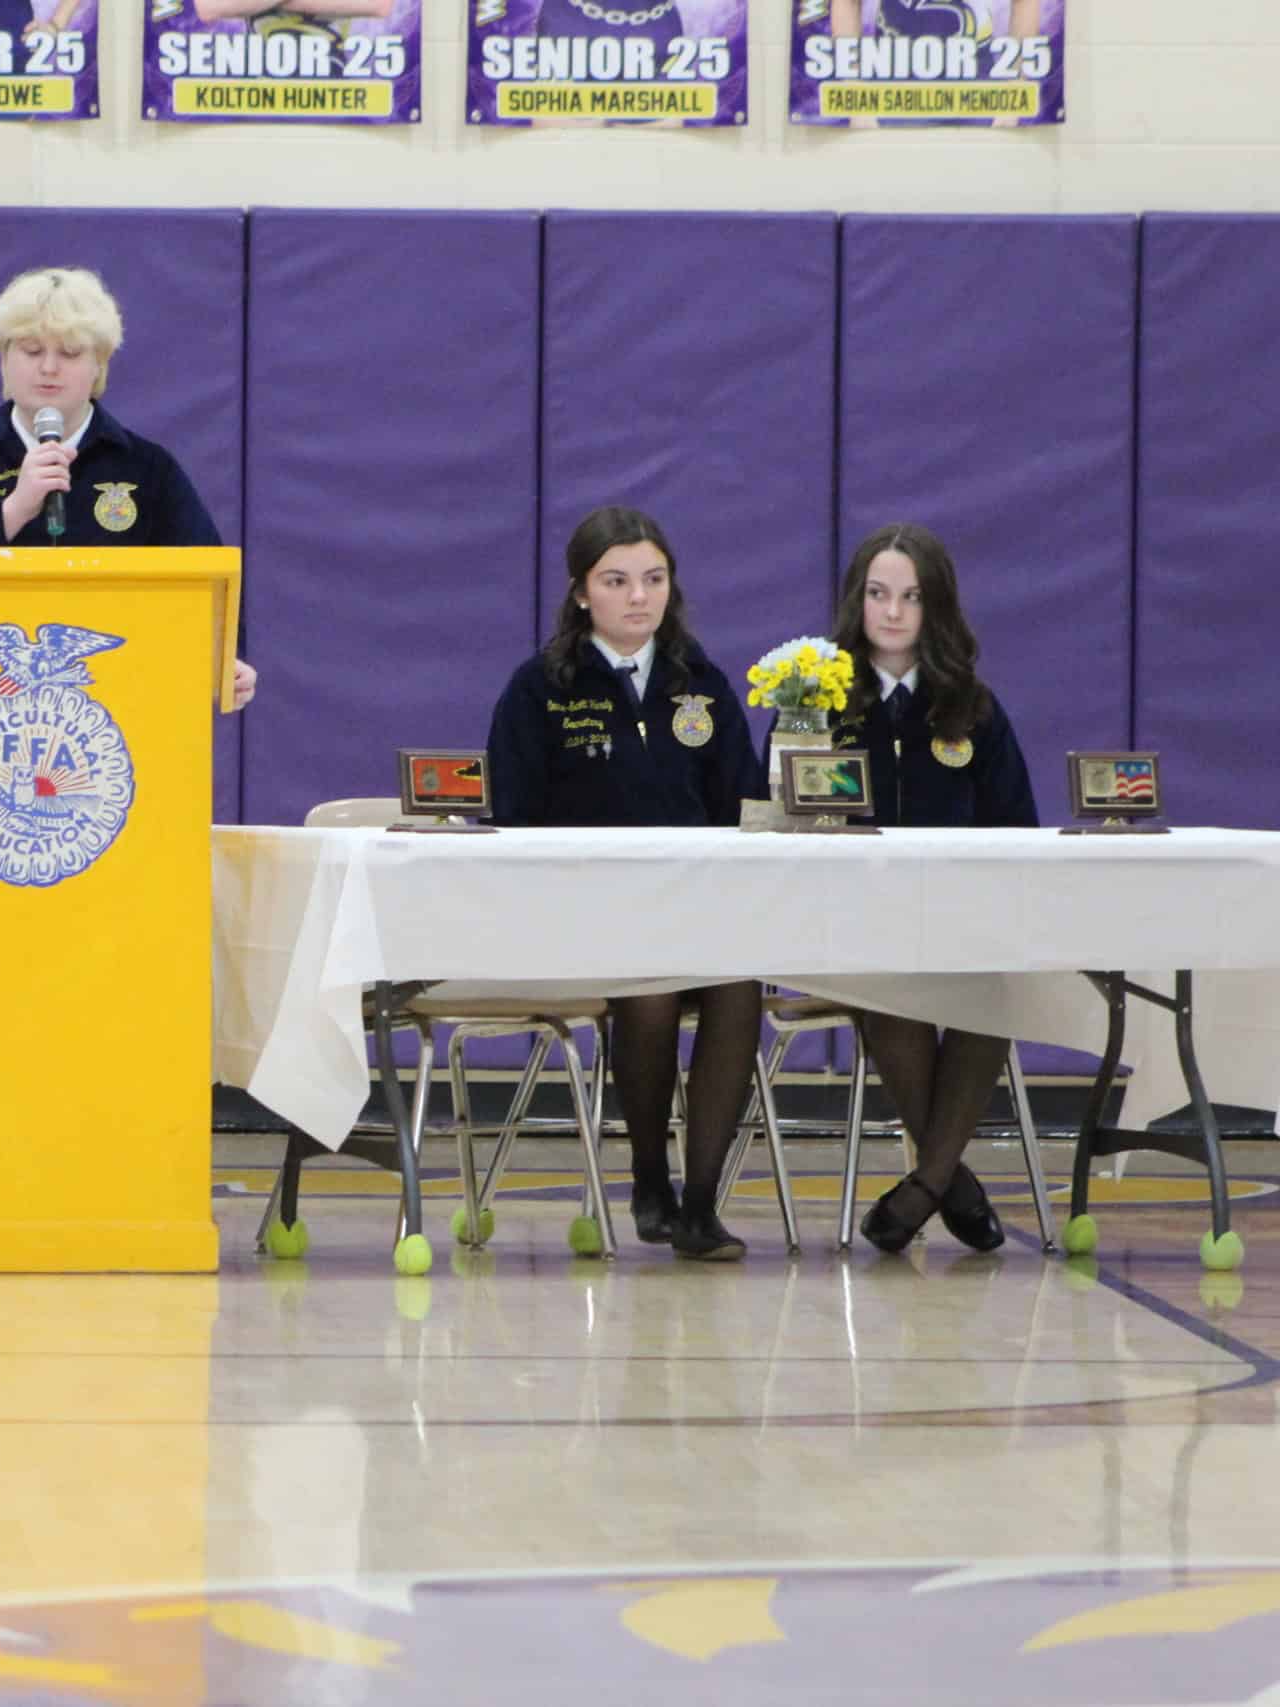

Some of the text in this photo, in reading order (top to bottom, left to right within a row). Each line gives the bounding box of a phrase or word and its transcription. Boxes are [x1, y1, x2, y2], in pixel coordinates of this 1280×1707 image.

[23, 31, 85, 73] 25
[158, 32, 406, 77] SENIOR 25
[482, 35, 730, 80] SENIOR 25
[804, 35, 1052, 80] SENIOR 25
[196, 87, 368, 109] KOLTON HUNTER
[509, 90, 702, 112] SOPHIA MARSHALL
[828, 90, 1029, 111] FABIAN SABILLON MENDOZA
[1, 733, 77, 771] FFA
